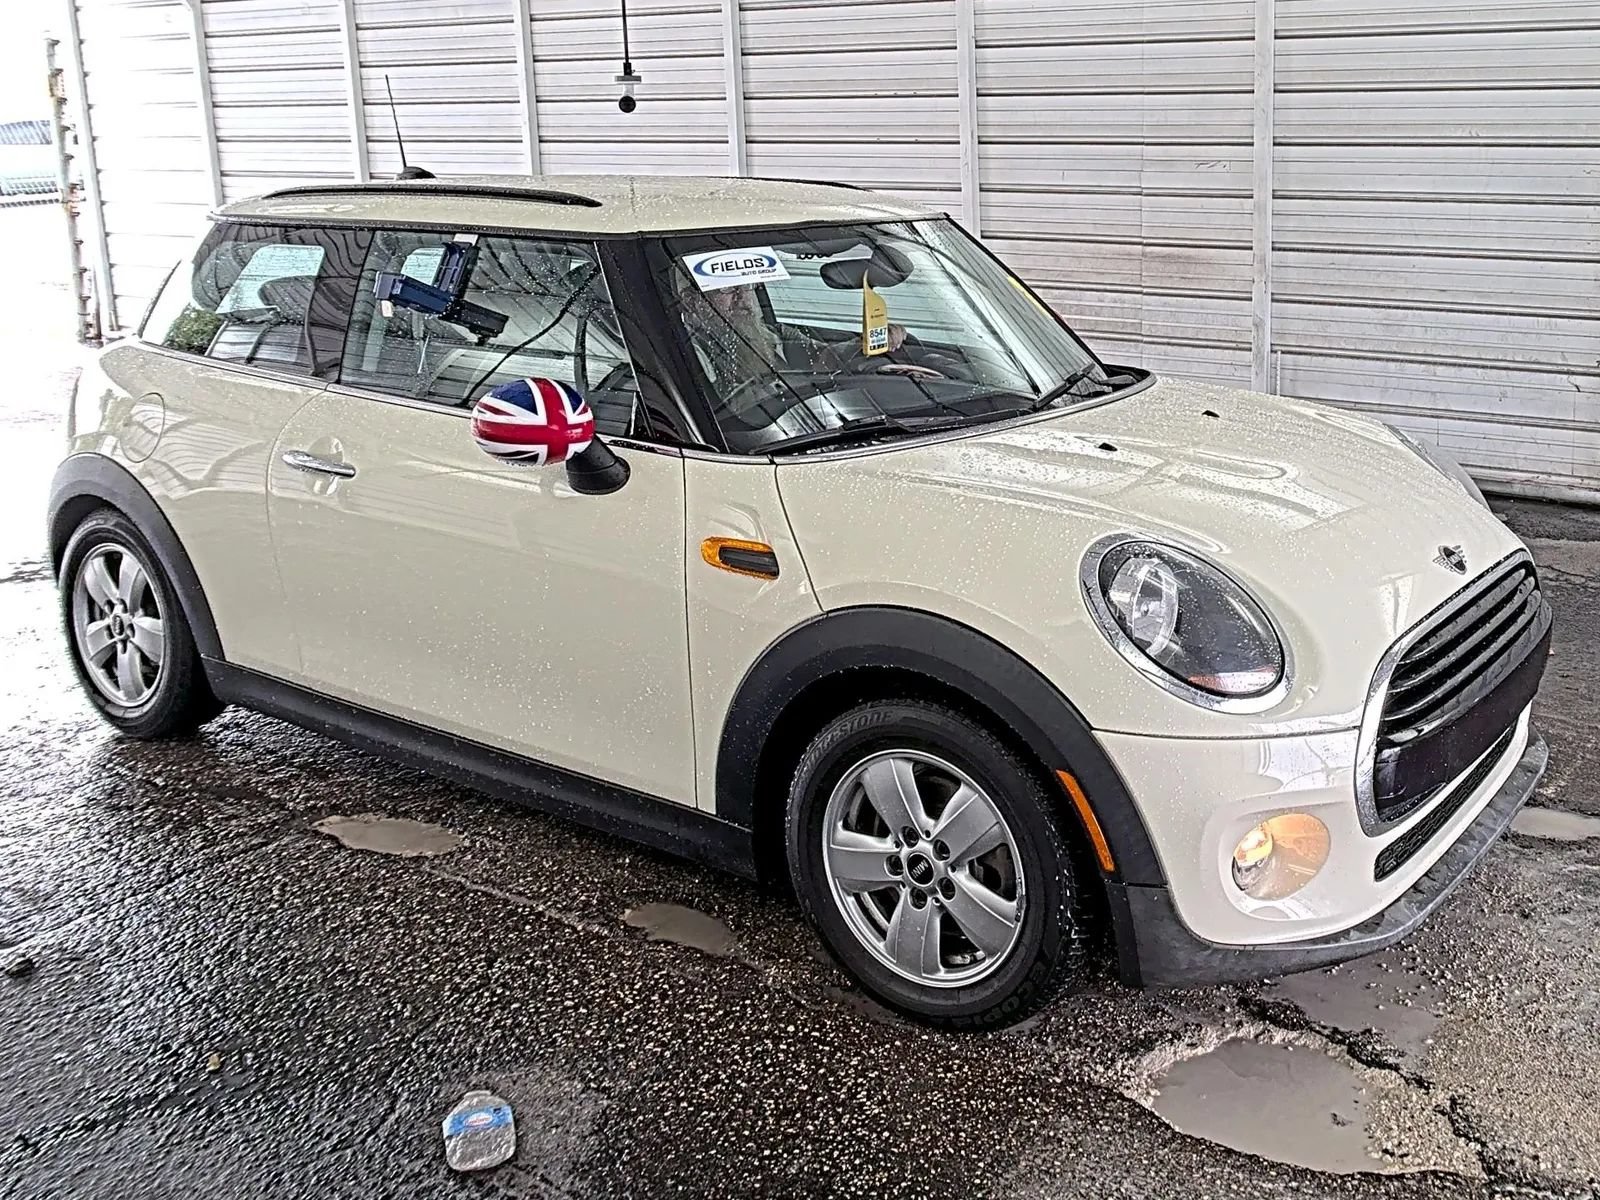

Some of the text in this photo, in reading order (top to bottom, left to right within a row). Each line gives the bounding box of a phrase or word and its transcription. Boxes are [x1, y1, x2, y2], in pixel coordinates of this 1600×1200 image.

[710, 257, 765, 274] FIELDS
[869, 327, 887, 338] 8547
[910, 859, 929, 879] MINI
